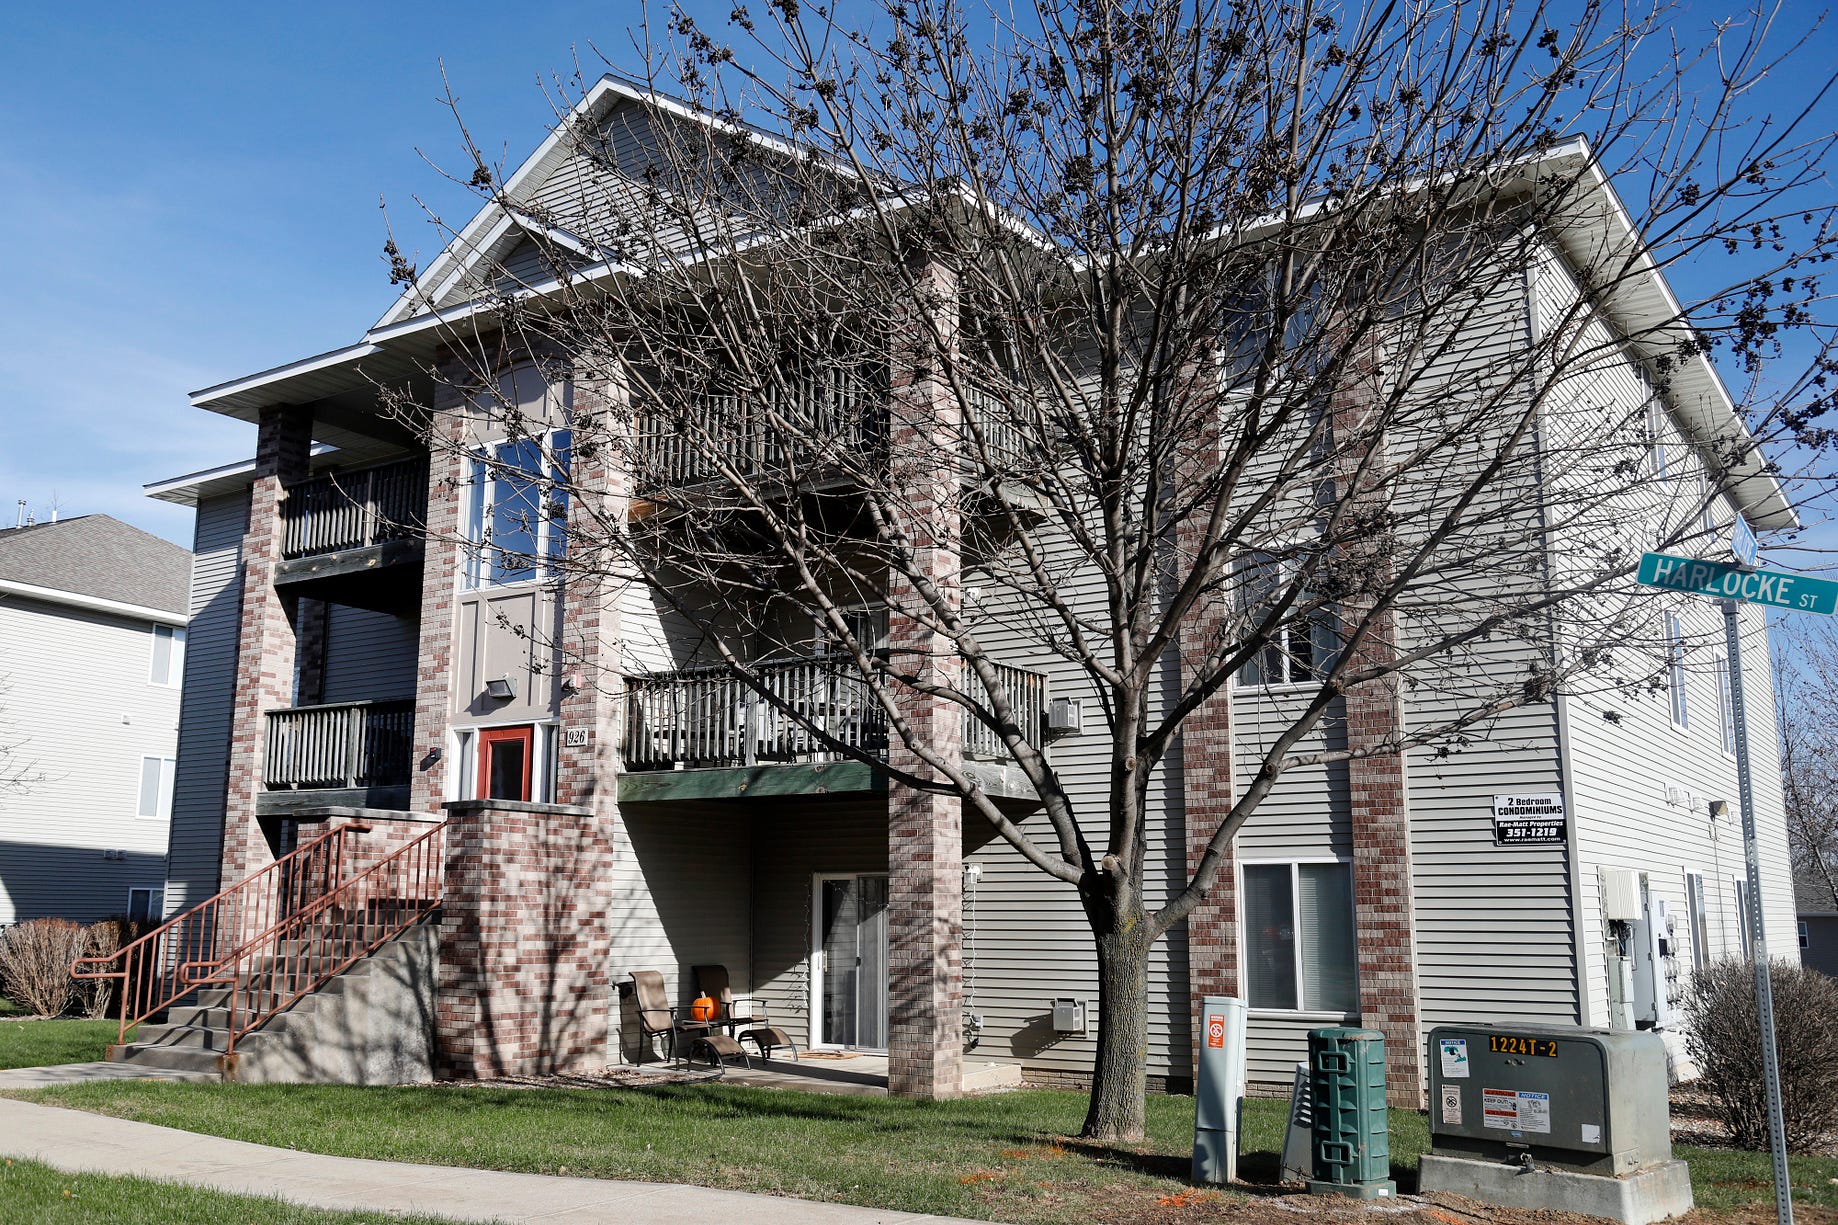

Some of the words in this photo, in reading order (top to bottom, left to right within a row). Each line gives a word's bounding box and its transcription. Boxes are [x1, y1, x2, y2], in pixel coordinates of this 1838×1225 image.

[1653, 558, 1795, 605] HARLOCKE
[1798, 593, 1818, 609] ST
[568, 730, 585, 744] 926
[1507, 797, 1514, 806] 2
[1516, 797, 1552, 806] Bedroom
[1498, 805, 1563, 816] CONDOMINIUMS
[1506, 827, 1557, 837] 351-1219
[1491, 1036, 1557, 1057] 1224T-2
